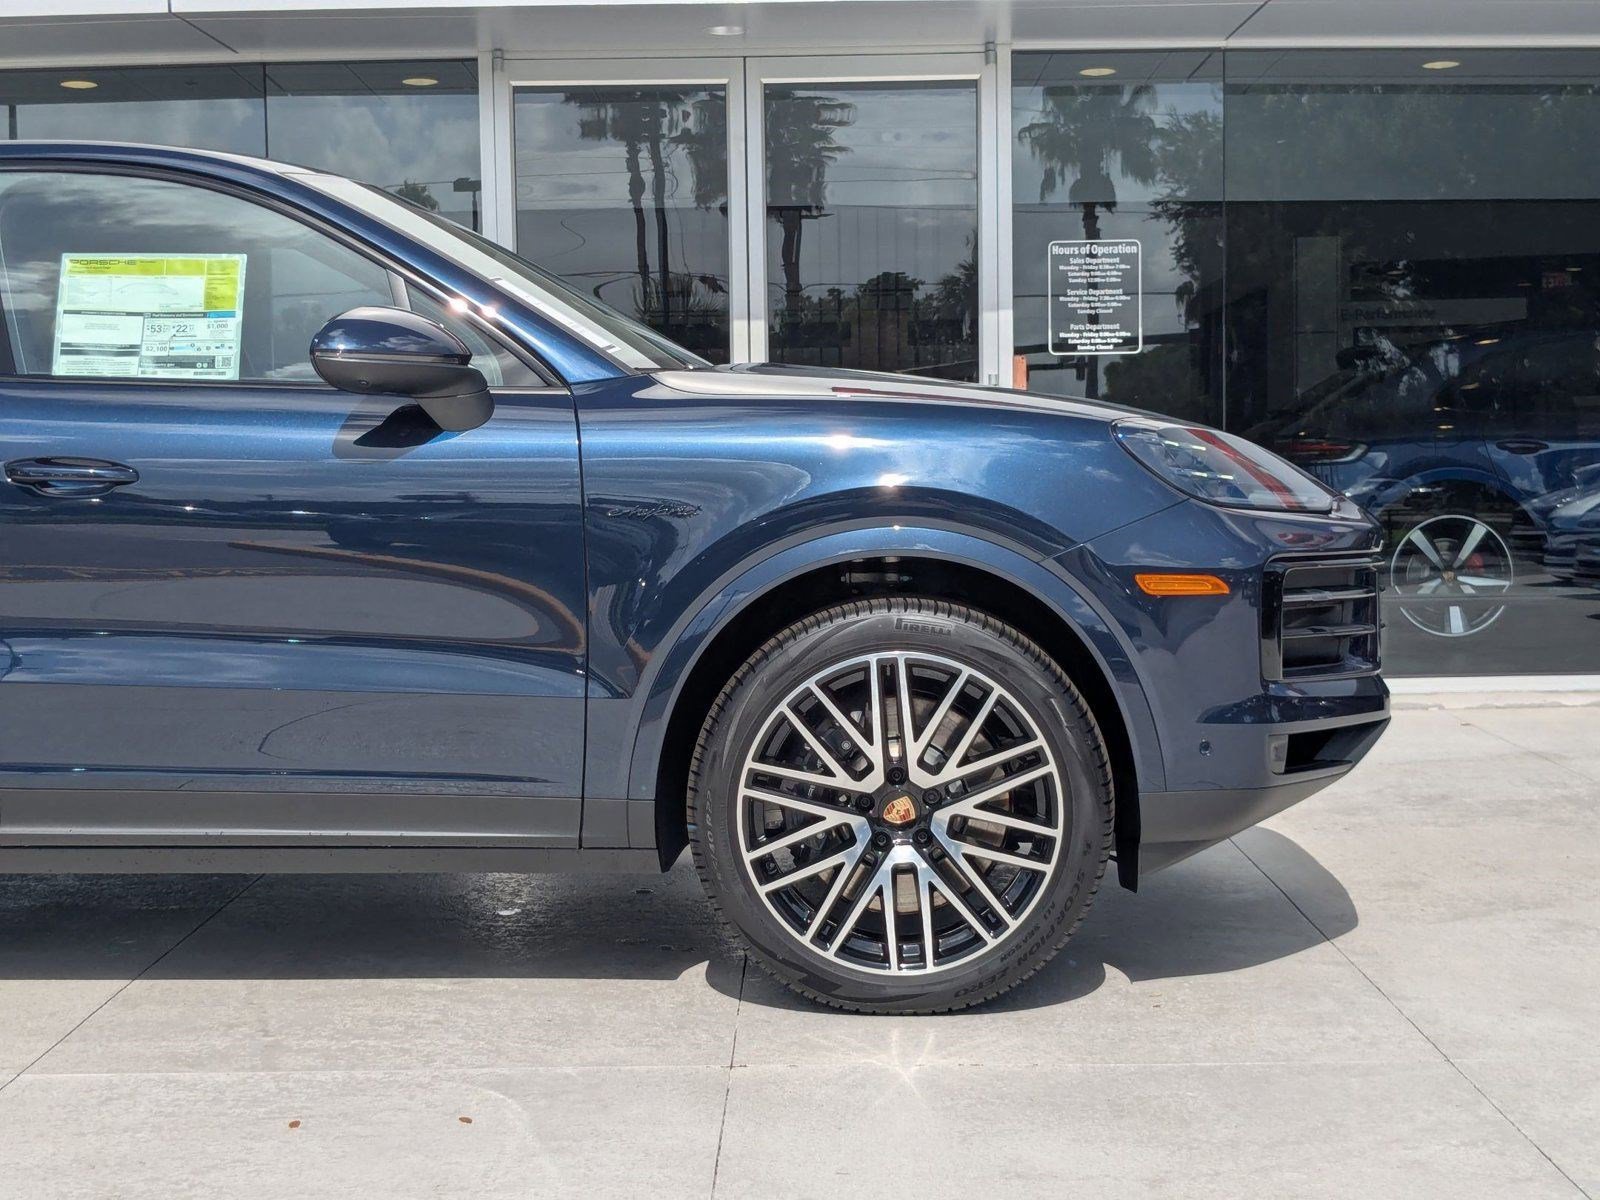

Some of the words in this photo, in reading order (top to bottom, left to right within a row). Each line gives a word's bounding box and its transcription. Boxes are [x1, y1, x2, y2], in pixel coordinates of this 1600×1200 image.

[1052, 245, 1079, 255] Hours
[1080, 244, 1090, 254] of
[1091, 244, 1137, 256] Operation
[1085, 257, 1120, 265] Department
[1088, 288, 1123, 297] Department
[150, 324, 162, 333] 53
[176, 324, 188, 333] 22
[1085, 323, 1120, 332] Department
[146, 345, 168, 353] $2,100
[895, 618, 952, 636] PIRELLI
[1017, 870, 1086, 966] SCORPION
[954, 967, 1009, 998] ZERO
